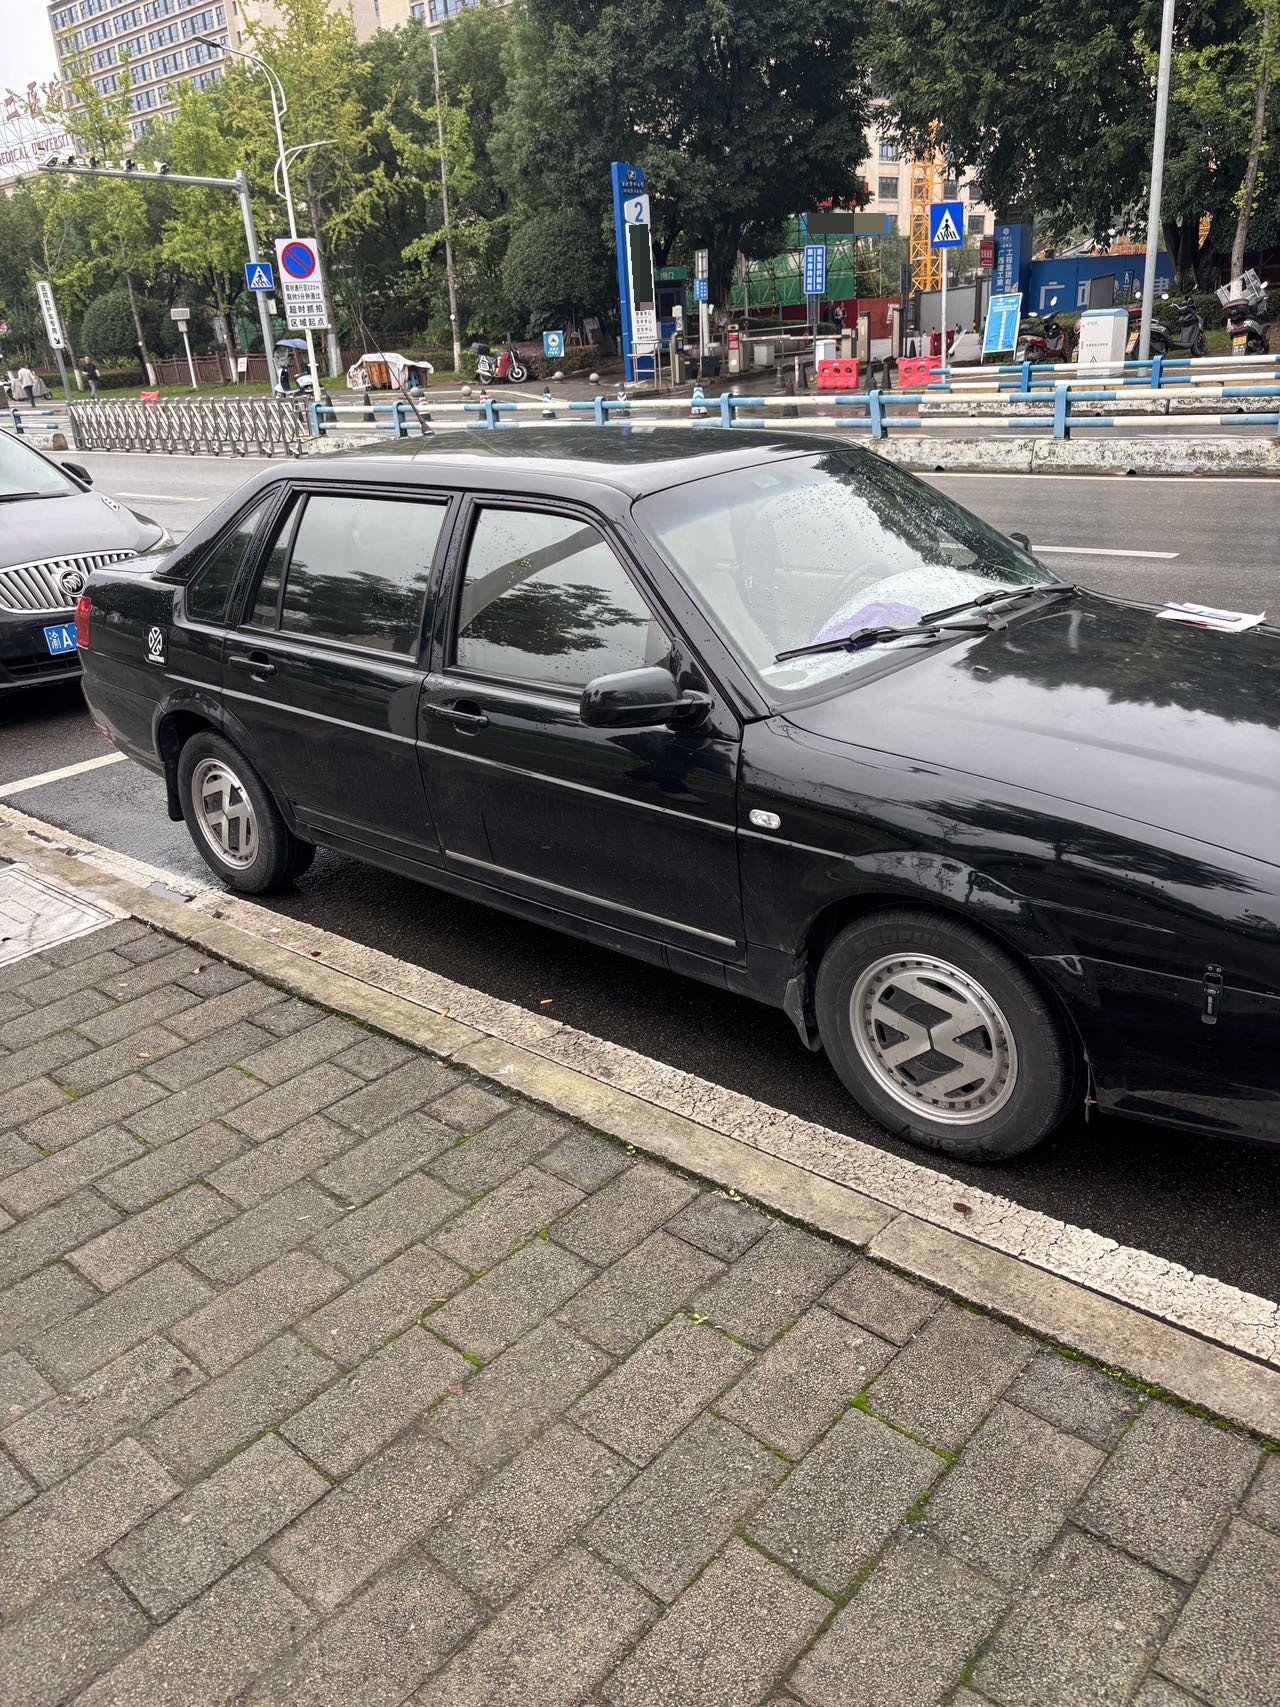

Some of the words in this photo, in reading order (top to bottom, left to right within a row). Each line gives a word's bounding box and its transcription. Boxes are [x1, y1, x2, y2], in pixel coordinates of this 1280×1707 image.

[634, 201, 644, 223] 2
[289, 304, 323, 315] 超时抓拍
[290, 317, 325, 328] 区域起点
